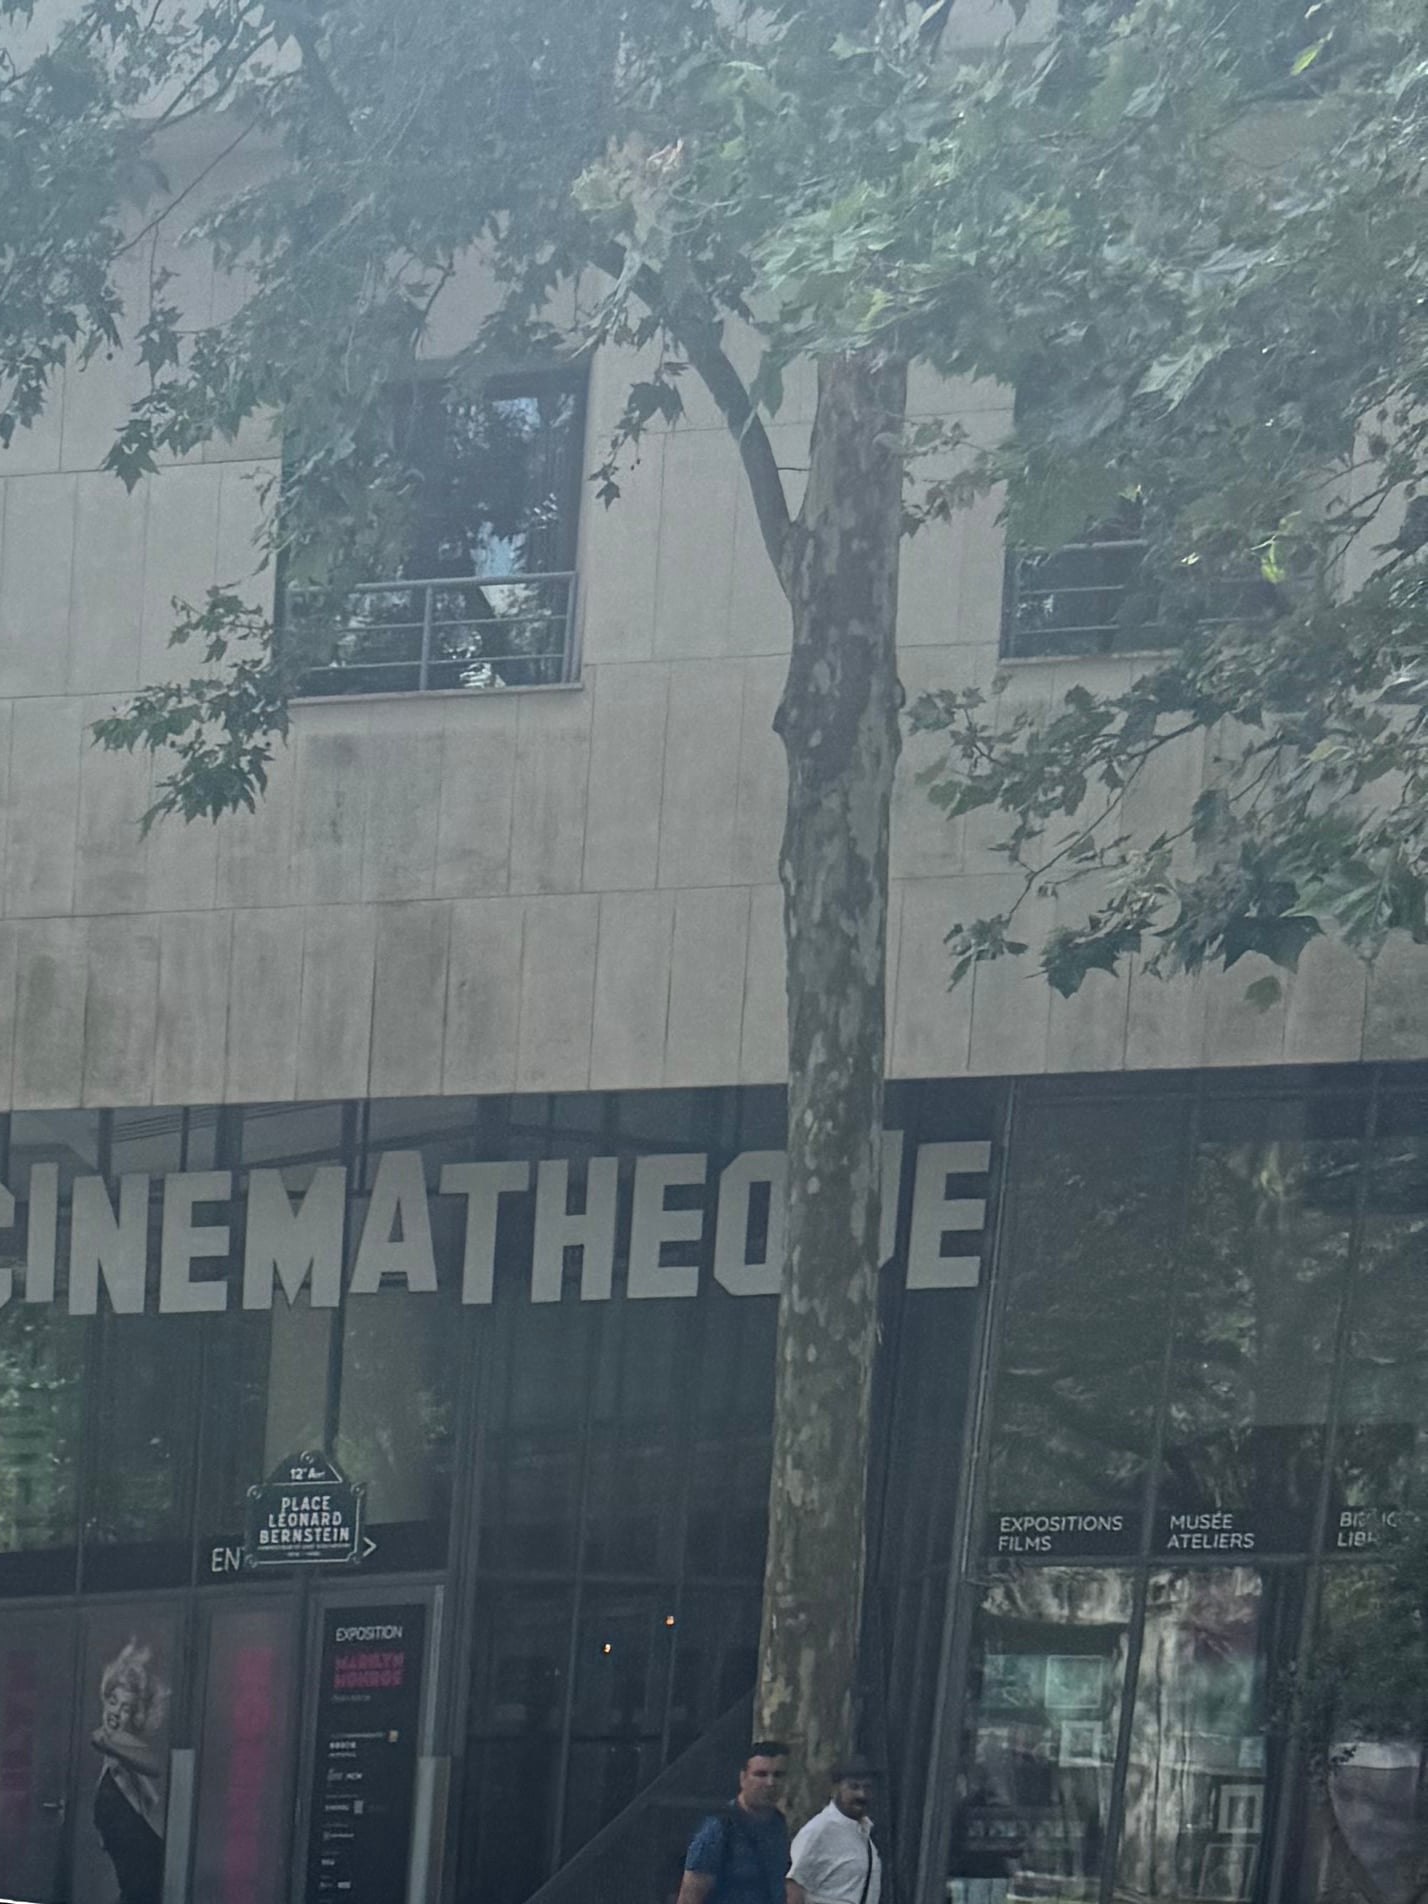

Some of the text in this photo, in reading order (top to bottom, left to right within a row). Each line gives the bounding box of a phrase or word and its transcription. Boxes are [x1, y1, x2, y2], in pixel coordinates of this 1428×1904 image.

[281, 1496, 332, 1512] PLACE
[999, 1515, 1124, 1533] EXPOSITIONS
[1169, 1511, 1235, 1530] MUSÉE
[259, 1527, 350, 1545] BERNSTEIN
[997, 1535, 1053, 1552] FILMS
[1166, 1532, 1256, 1550] ATELIERS
[335, 1625, 404, 1642] EXPOSITION
